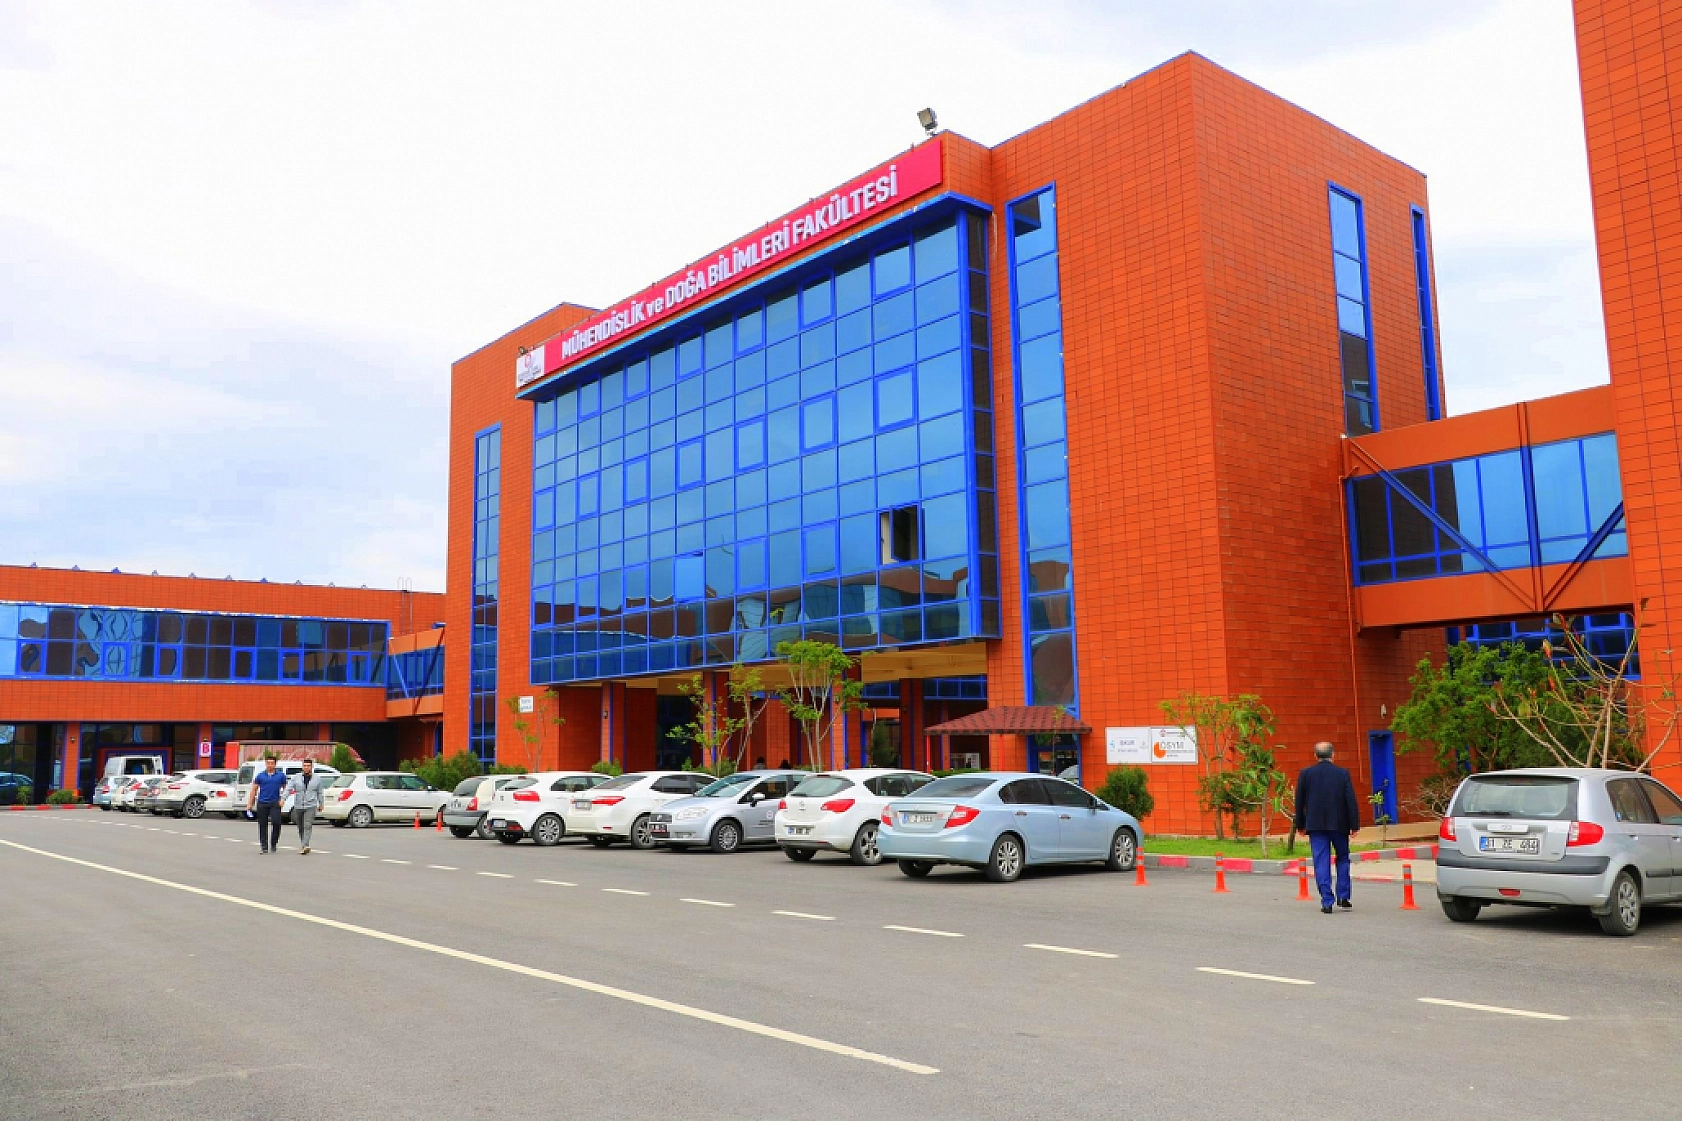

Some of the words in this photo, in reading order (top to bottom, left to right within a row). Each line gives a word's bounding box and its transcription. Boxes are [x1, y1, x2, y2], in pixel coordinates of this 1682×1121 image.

[562, 300, 646, 360] MÜHENDİSLİK
[646, 297, 664, 317] ve
[665, 269, 706, 308] DOĞA
[708, 220, 790, 287] BİLİMLERİ
[792, 165, 898, 245] FAKÜLTESİ
[203, 743, 209, 753] B
